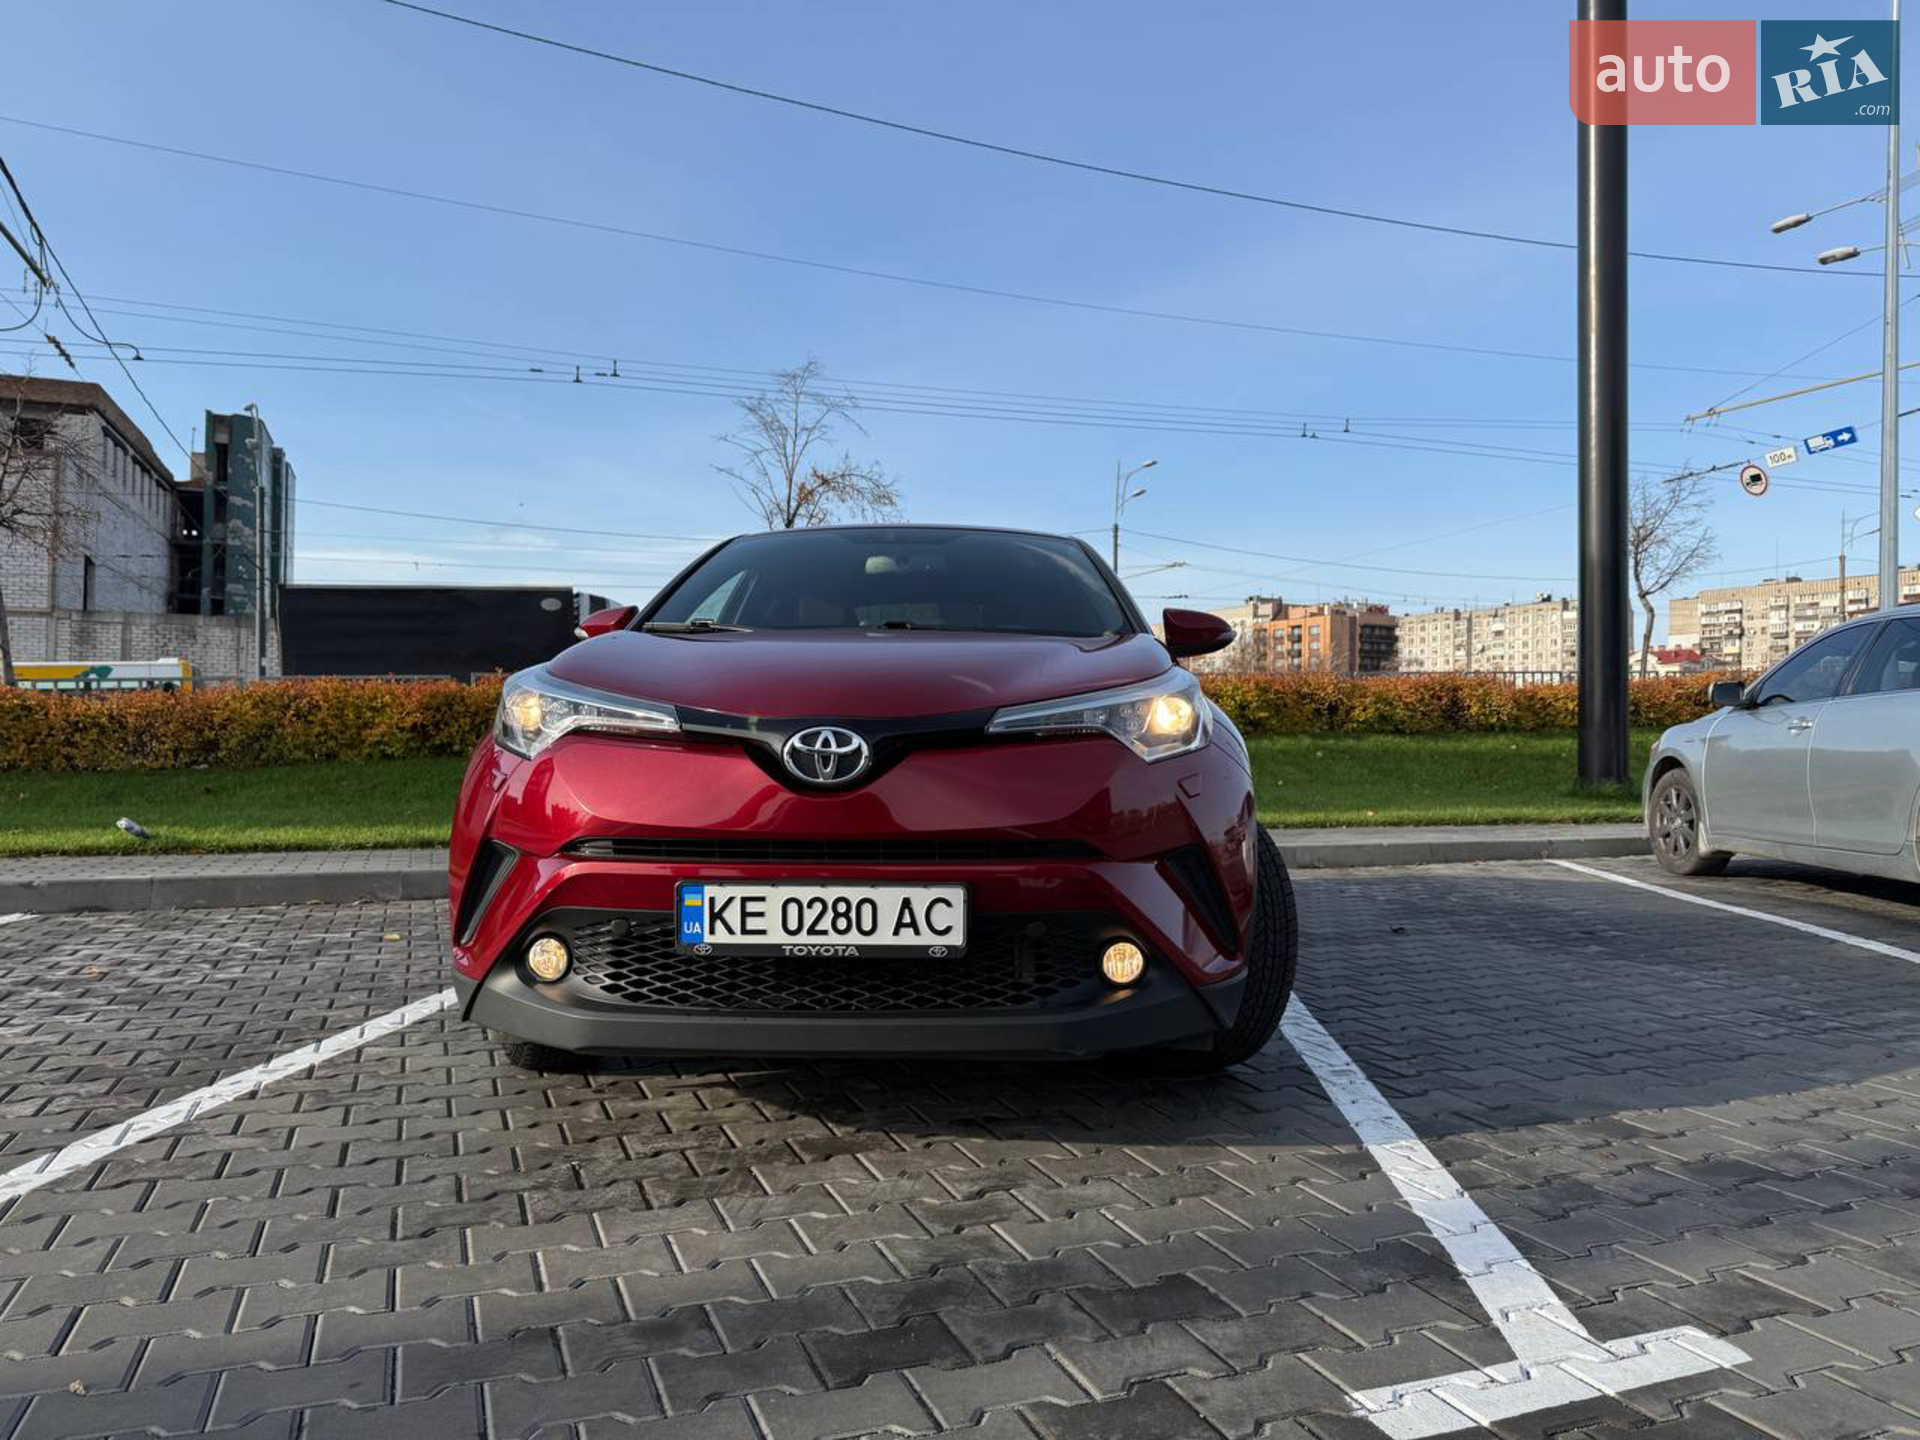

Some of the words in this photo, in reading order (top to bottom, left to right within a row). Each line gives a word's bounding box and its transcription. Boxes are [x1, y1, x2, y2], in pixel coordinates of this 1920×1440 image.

[708, 895, 767, 936] KE
[781, 896, 878, 936] 0280
[892, 896, 954, 936] AC
[684, 922, 702, 935] UA
[781, 945, 859, 957] TOYOTA
